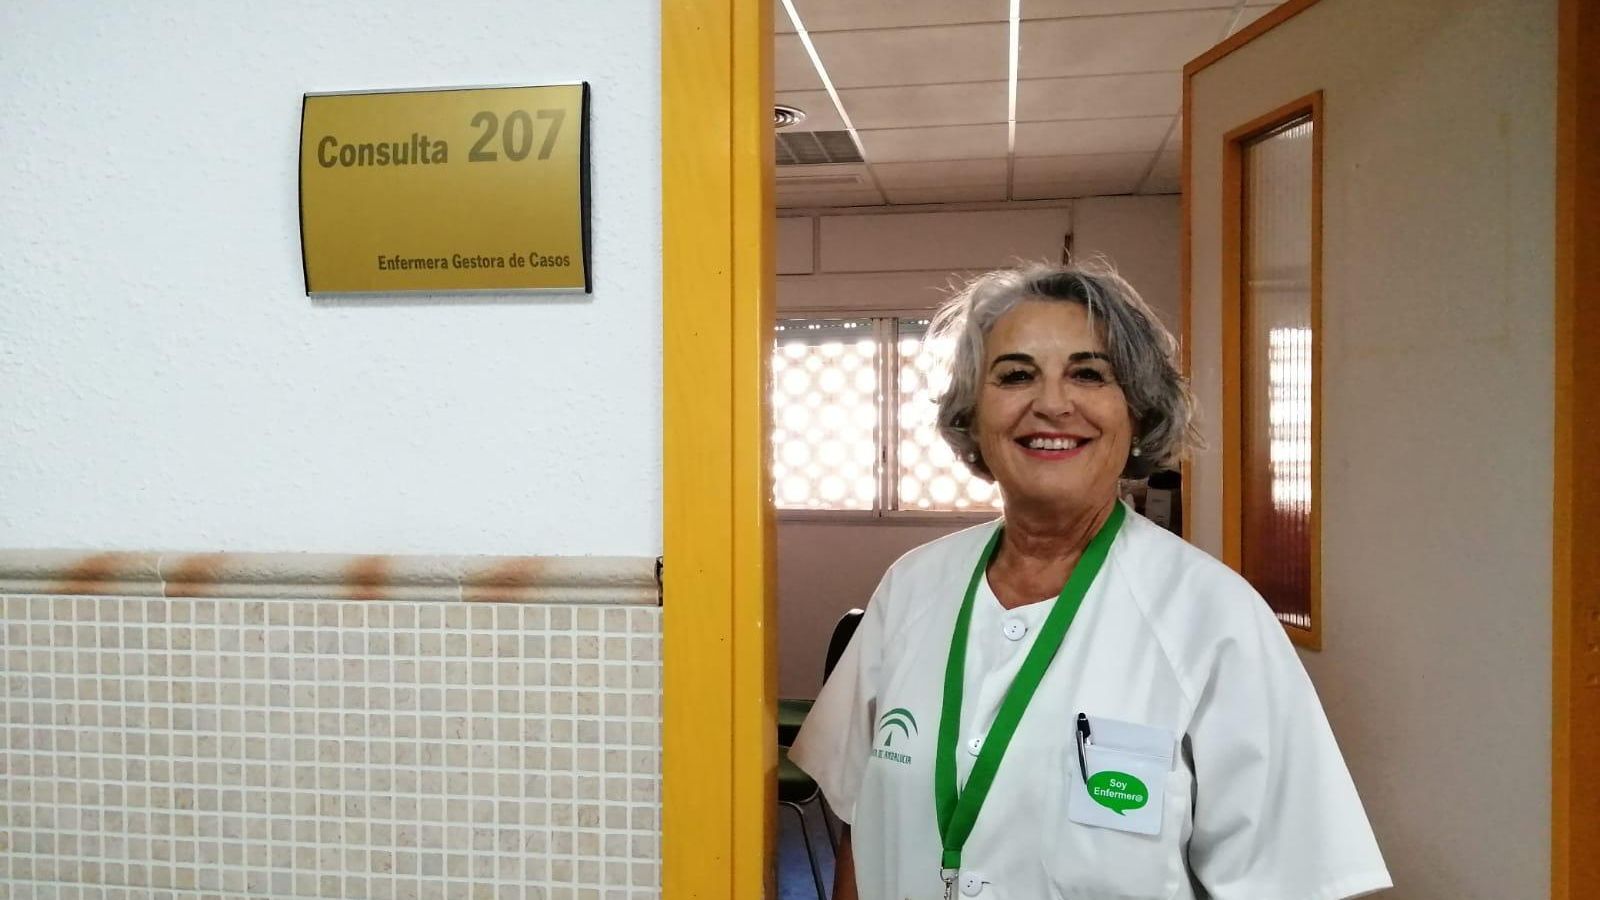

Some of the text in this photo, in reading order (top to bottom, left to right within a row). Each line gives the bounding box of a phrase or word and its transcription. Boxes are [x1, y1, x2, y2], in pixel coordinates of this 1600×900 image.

[317, 109, 566, 168] Consulta 207
[378, 252, 570, 270] Enfermera Gestora de Casos
[1109, 778, 1128, 790] Soy
